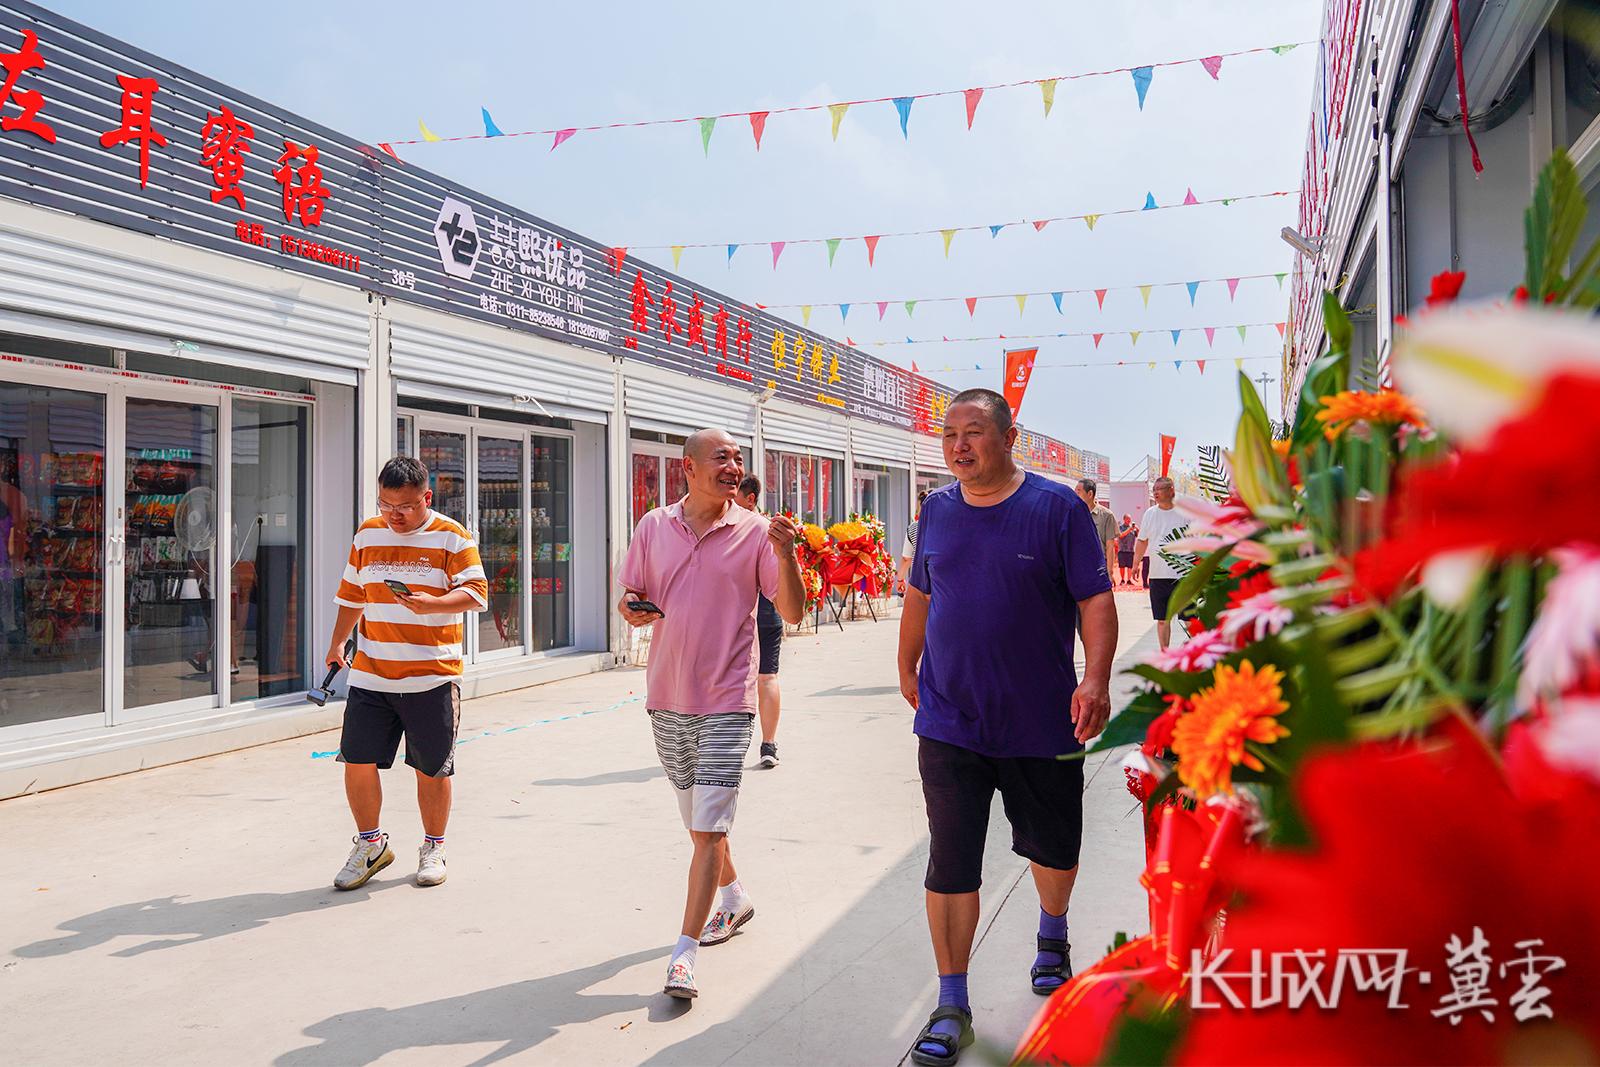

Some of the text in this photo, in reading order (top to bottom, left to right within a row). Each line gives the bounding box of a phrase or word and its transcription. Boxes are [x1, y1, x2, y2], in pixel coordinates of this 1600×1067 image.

[0, 29, 331, 228] 左耳蜜语
[490, 269, 584, 315] ZHE XI YOU PIN
